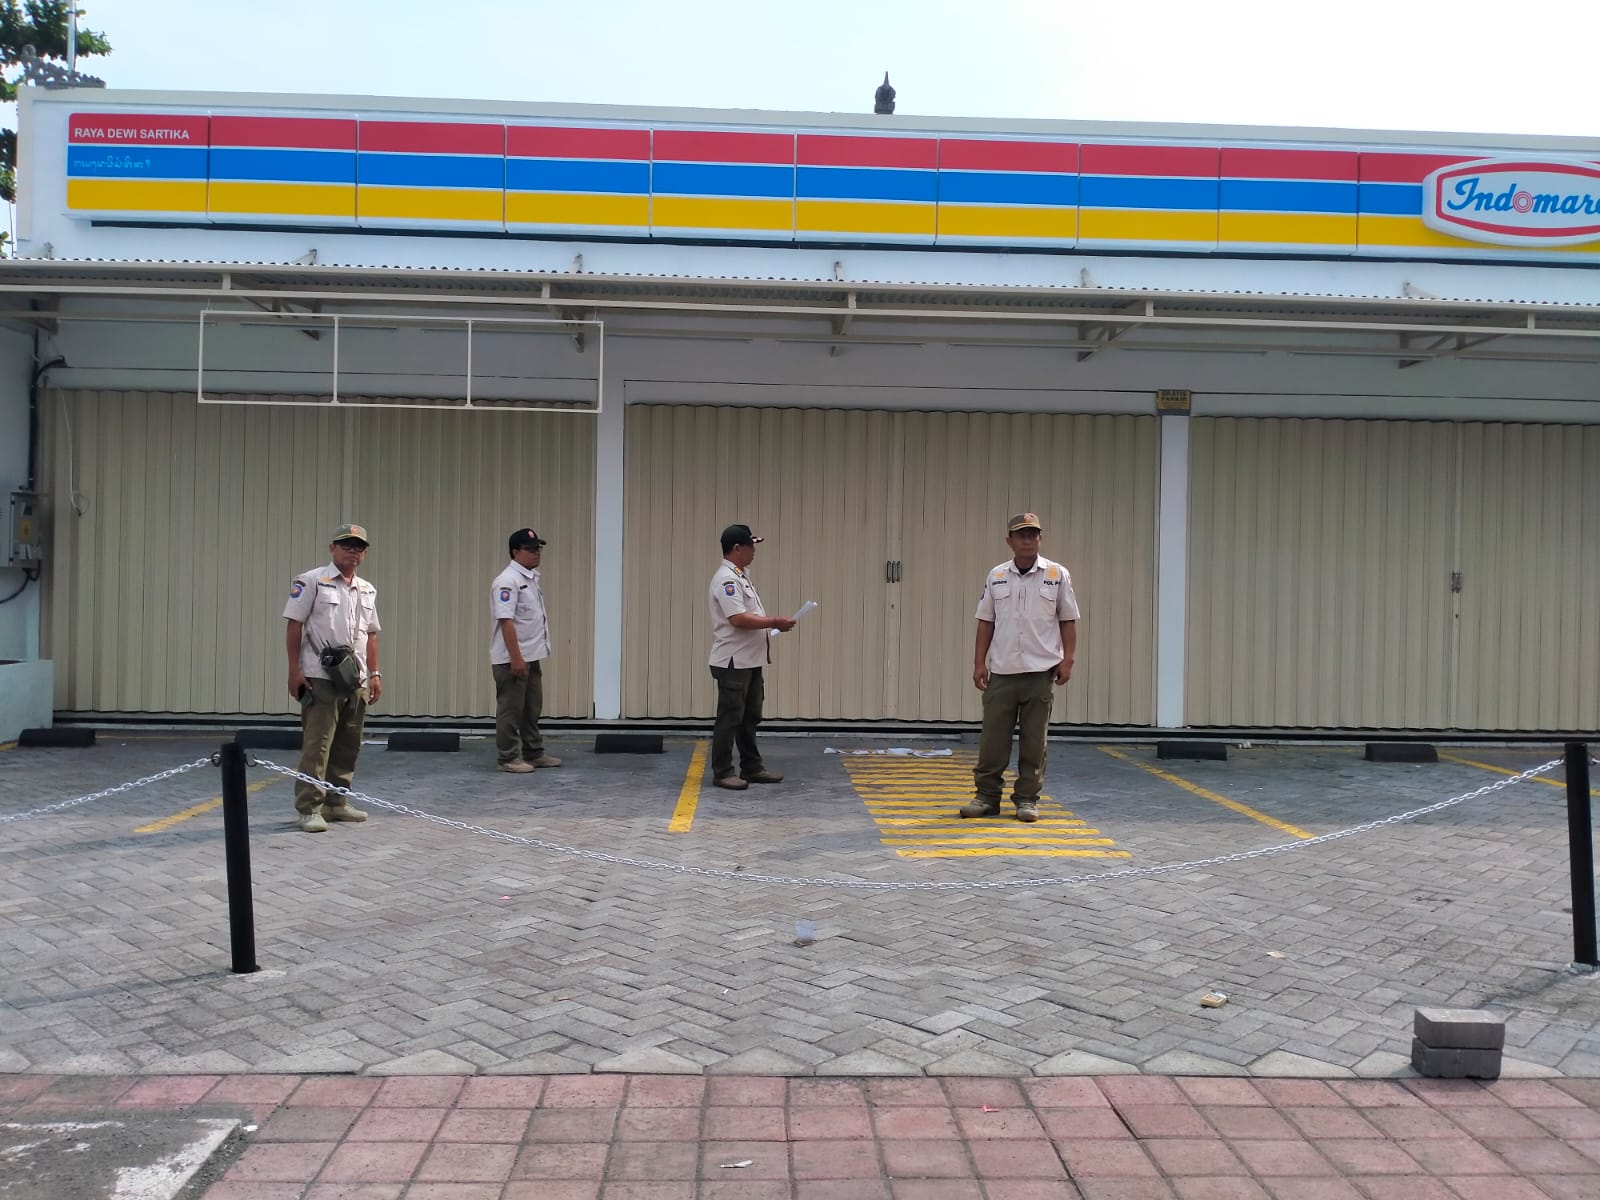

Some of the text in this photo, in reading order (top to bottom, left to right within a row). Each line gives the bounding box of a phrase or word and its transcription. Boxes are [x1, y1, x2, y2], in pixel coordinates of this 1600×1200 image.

[74, 127, 190, 139] RAYA DEWI SARTIKA
